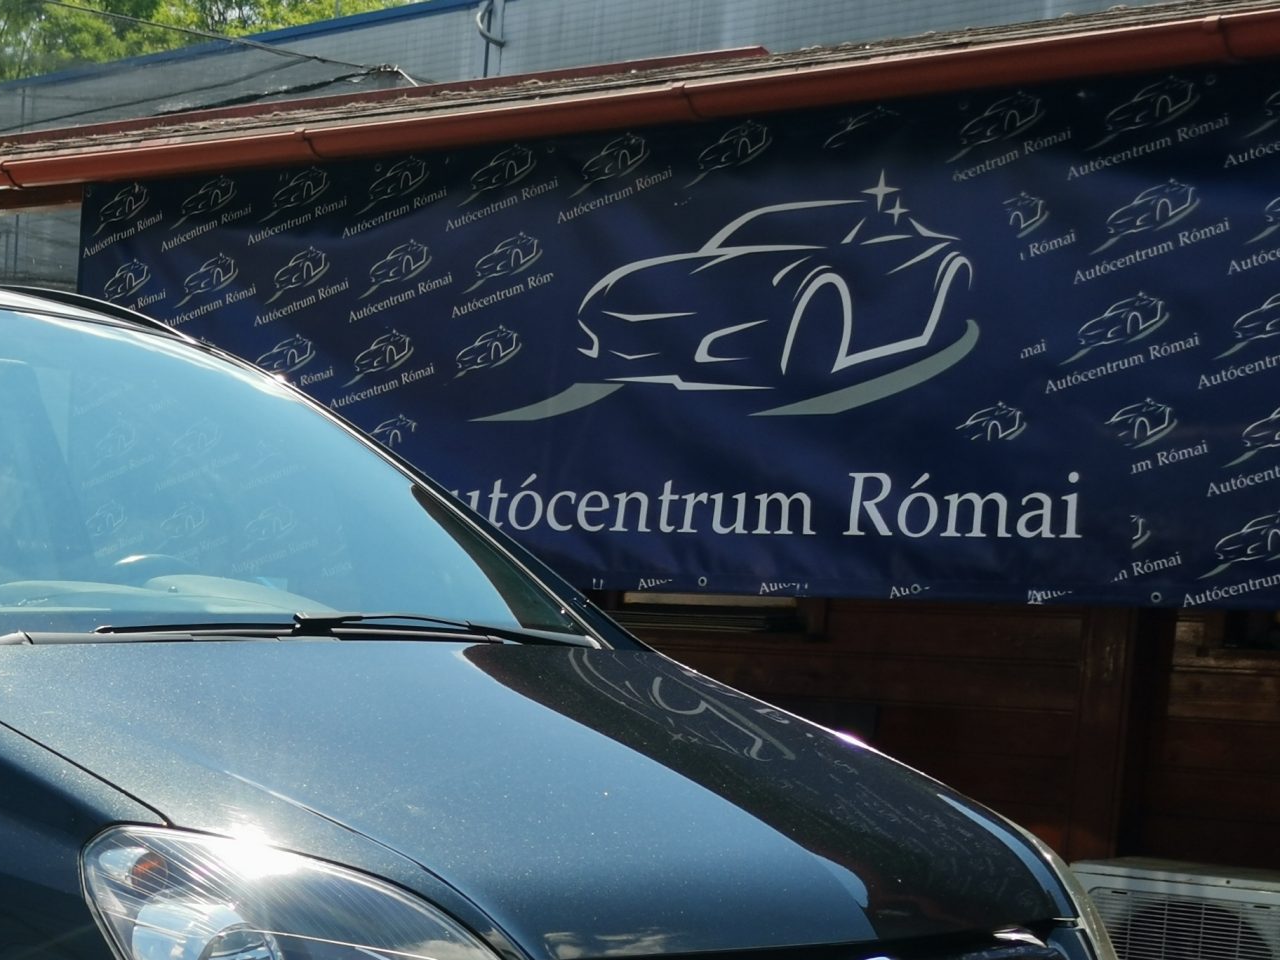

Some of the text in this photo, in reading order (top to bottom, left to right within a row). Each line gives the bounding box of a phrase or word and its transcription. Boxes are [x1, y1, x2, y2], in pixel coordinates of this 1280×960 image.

[1023, 127, 1072, 155] Római
[1066, 112, 1231, 181] Autócentrum Római
[342, 186, 448, 239] Autócentrum Római
[445, 176, 559, 232] Autócentrum Római
[557, 166, 673, 224] Autócentrum Római
[83, 210, 163, 259] Autócentrum Római
[161, 203, 252, 252] Autócentrum Római
[247, 196, 348, 246] Autócentrum Római
[1028, 229, 1077, 258] Római
[1073, 217, 1231, 285] Autócentrum Római
[137, 288, 166, 309] Római
[225, 283, 257, 305] Római
[254, 278, 350, 327] Autócentrum Római
[349, 271, 453, 323] Autócentrum Római
[451, 283, 525, 318] Autócentrum
[300, 366, 335, 386] Római
[329, 363, 436, 410] Autócentrum Római
[1045, 332, 1201, 394] Autócentrum Római
[1157, 440, 1209, 467] Római
[841, 471, 1084, 539] Római
[1131, 551, 1183, 577] Római
